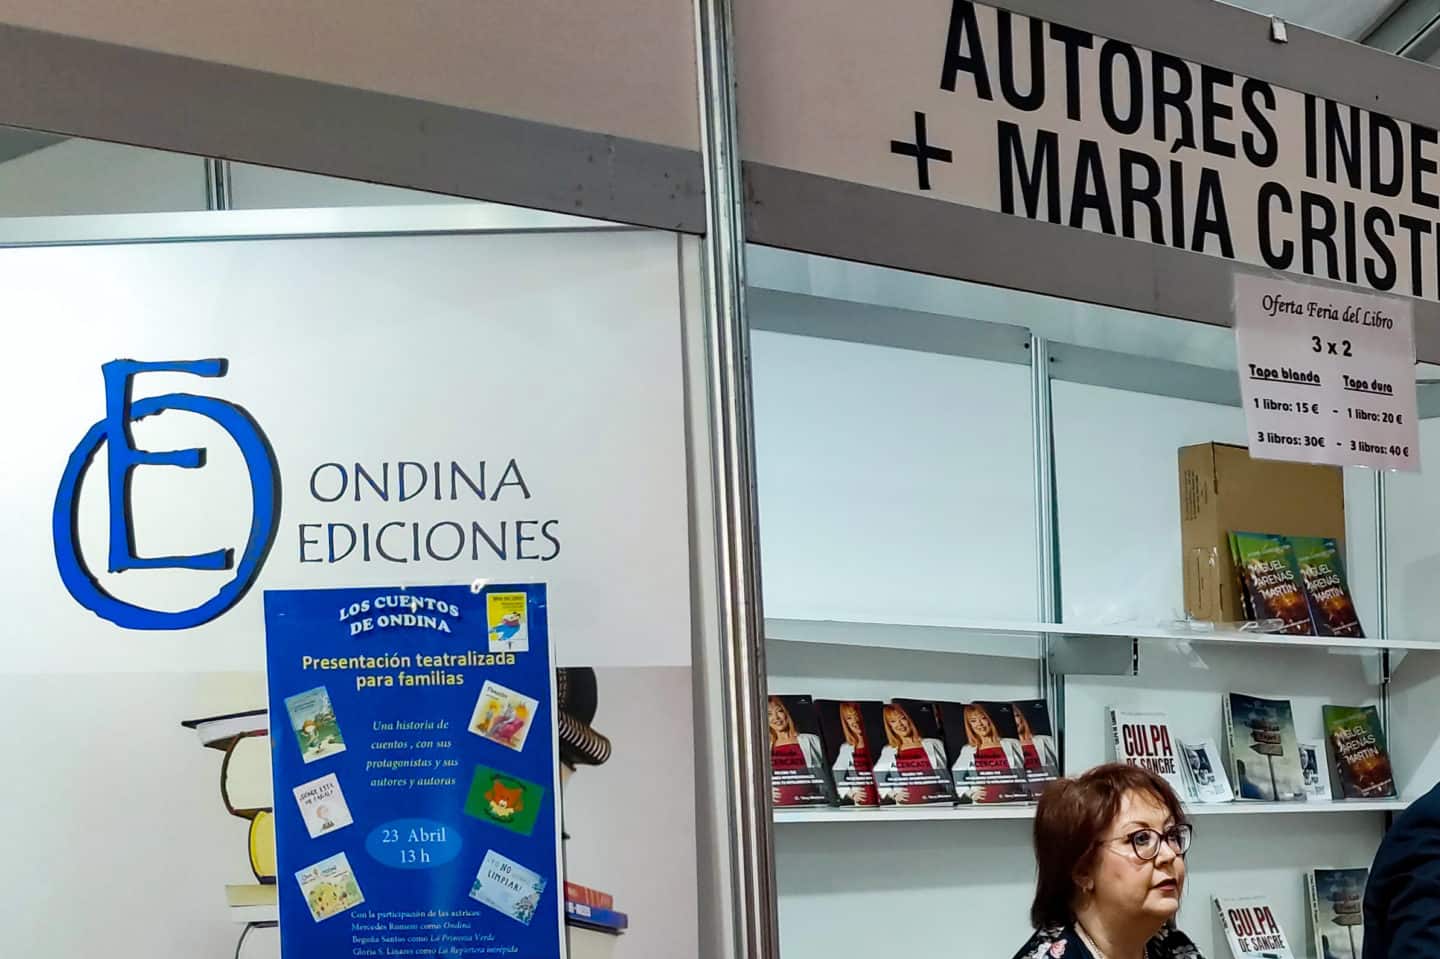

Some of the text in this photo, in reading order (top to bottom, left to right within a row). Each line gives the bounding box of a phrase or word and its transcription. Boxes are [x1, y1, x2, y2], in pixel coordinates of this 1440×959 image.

[940, 0, 1279, 168] AUTORES
[890, 111, 952, 190] +
[997, 119, 1235, 259] MARÍA
[1262, 295, 1393, 330] Oferta Feria del Libro
[1312, 336, 1352, 357] 3 x 2
[1249, 364, 1321, 384] Tapa blanda
[1343, 375, 1392, 393] Tapa dura
[1254, 398, 1259, 408] 1
[1263, 399, 1292, 412] libro:
[1296, 402, 1309, 413] 15
[1312, 403, 1319, 414] €
[1348, 408, 1352, 418] 1
[1355, 409, 1380, 422] libro:
[1382, 412, 1394, 424] 20
[1396, 414, 1403, 424] €
[1257, 432, 1264, 442] 3
[1267, 433, 1301, 446] libros:
[1304, 435, 1325, 448] 30€
[1350, 440, 1356, 451] 3
[1358, 442, 1388, 455] libros:
[1389, 446, 1401, 457] 40
[1403, 446, 1409, 457] €
[309, 458, 532, 503] ONDINA
[297, 518, 562, 564] EDICIONES
[1247, 559, 1286, 575] MIGUEL
[1300, 564, 1333, 581] MIGUEL
[1256, 570, 1294, 588] ARENAS
[1308, 575, 1341, 591] ARENAS
[339, 595, 460, 621] LOS CUENTOS
[350, 613, 452, 636] DE ONDINA
[302, 651, 516, 670] Presentación teatralizada
[356, 671, 464, 691] para familias
[372, 719, 449, 731] Una historia de
[370, 740, 407, 750] cuentos
[415, 740, 433, 749] con
[436, 740, 452, 748] sus
[1122, 724, 1173, 757] CULPA
[365, 758, 459, 772] protagonistas y sus
[370, 776, 456, 789] autores y autoras
[382, 826, 447, 843] 23 Abril
[400, 847, 430, 863] 13 h
[1228, 906, 1280, 938] CULPA
[1238, 934, 1286, 953] DE SANGRE
